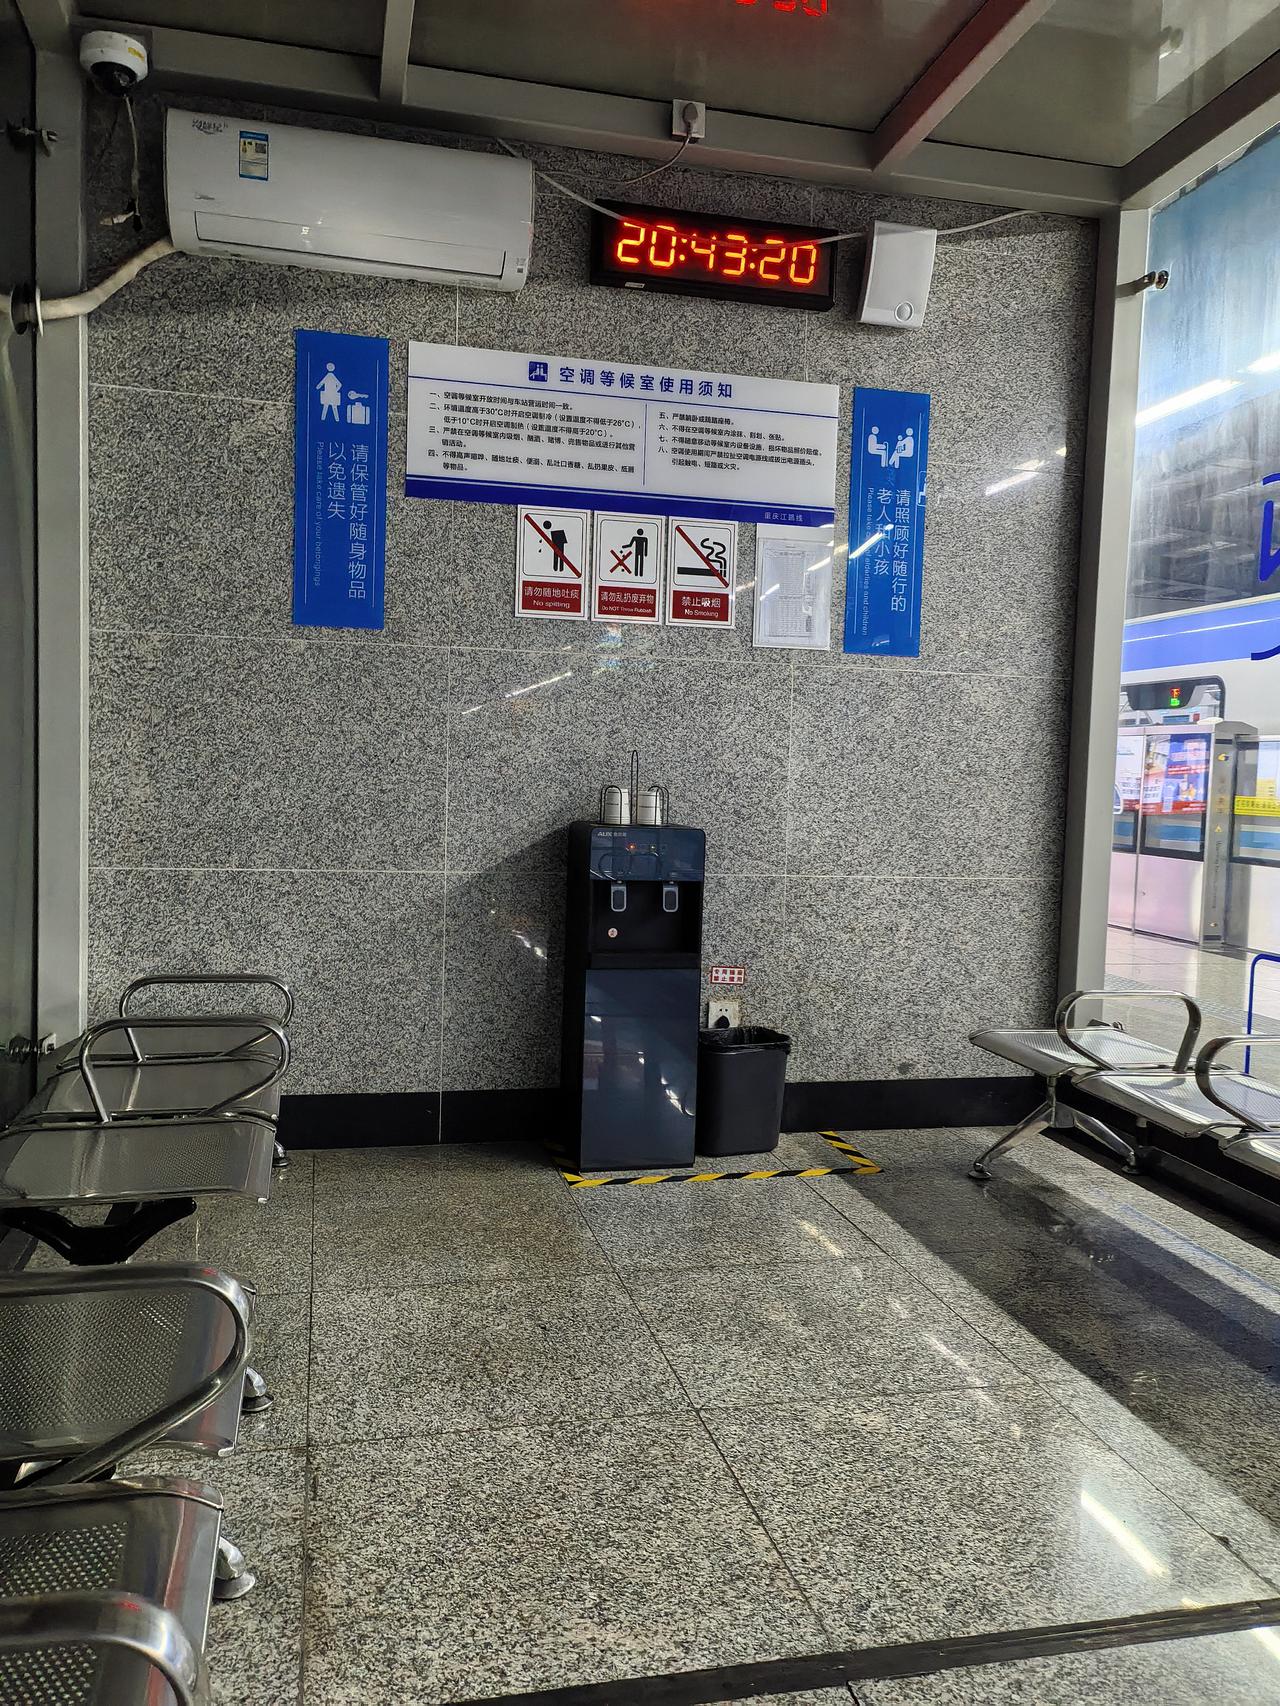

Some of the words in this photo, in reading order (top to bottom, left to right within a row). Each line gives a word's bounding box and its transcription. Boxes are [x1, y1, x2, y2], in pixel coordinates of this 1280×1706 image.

[616, 221, 817, 284] 20:43:20
[559, 366, 733, 398] 空调等候室使用须知
[316, 441, 324, 471] Please
[327, 441, 346, 520] 以免遗失
[314, 520, 322, 539] your
[348, 443, 369, 600] 请保管好随身物品
[874, 488, 893, 576] 老人和小孩
[313, 541, 322, 587] belongings
[891, 489, 911, 612] 请照顾好随行的
[524, 586, 579, 600] 请勿随地吐痰
[545, 601, 570, 609] spitting
[600, 591, 655, 604] 请勿乱扔废弃物
[681, 596, 721, 608] 禁止吸烟
[684, 608, 693, 616] No
[694, 609, 719, 618] Smoking
[862, 606, 870, 636] children
